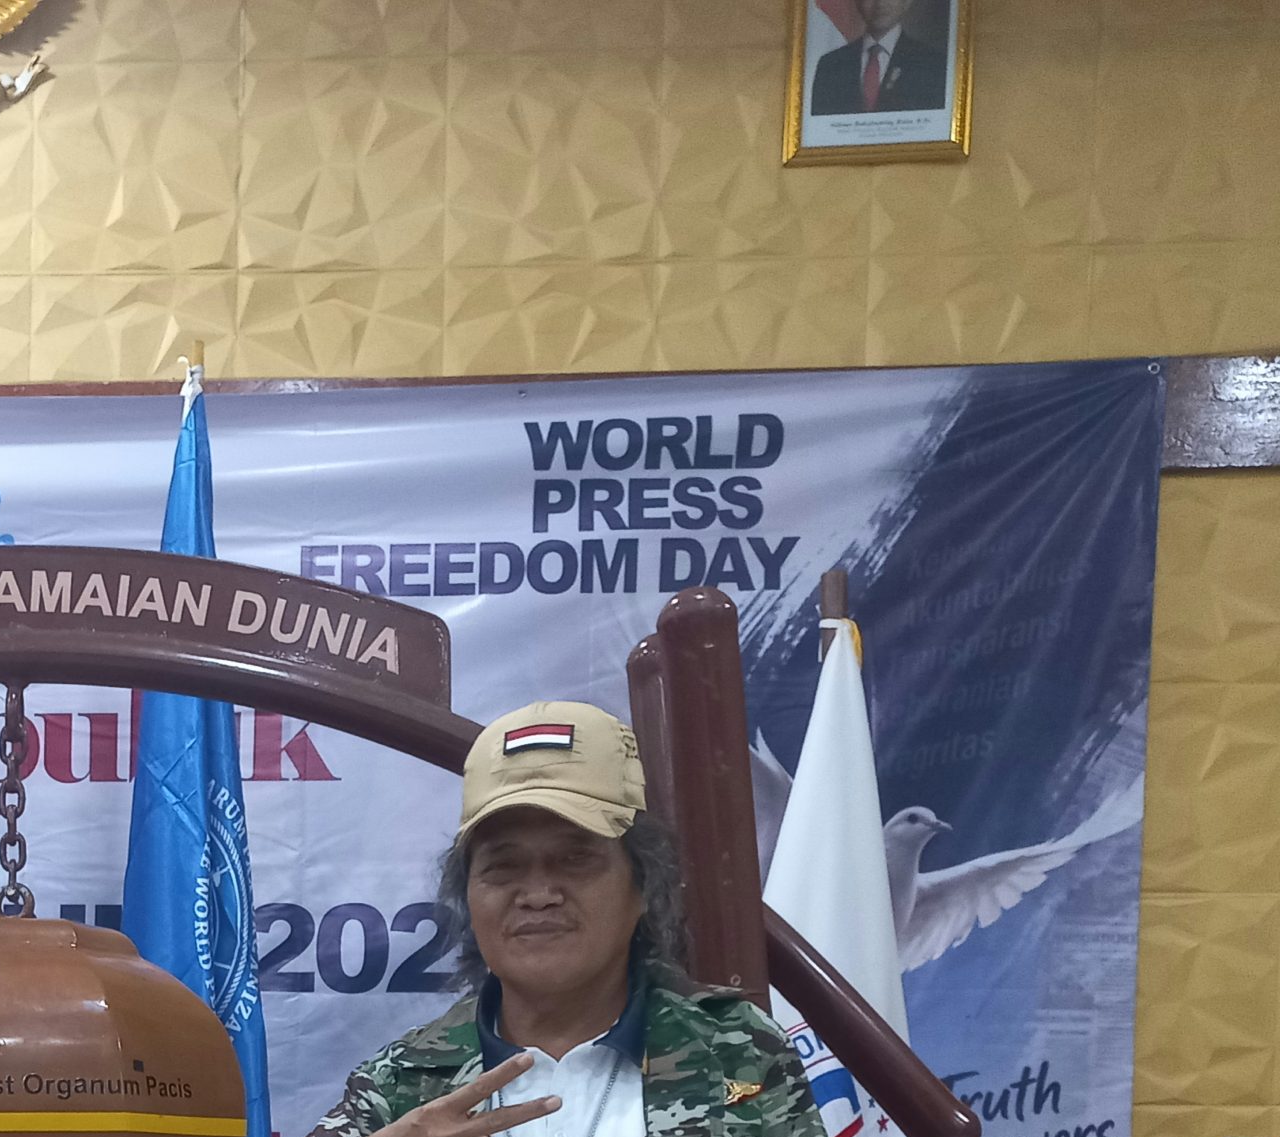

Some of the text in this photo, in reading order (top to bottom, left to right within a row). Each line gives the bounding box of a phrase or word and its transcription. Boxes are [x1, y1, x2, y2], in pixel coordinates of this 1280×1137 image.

[524, 413, 784, 471] WORLD
[532, 476, 763, 533] PRESS
[300, 537, 801, 597] FREEDOM DAY
[227, 590, 400, 675] DUNIA
[194, 877, 212, 970] WORLD
[252, 902, 460, 993] 202
[22, 1073, 141, 1099] Organum
[146, 1076, 192, 1099] Pacis
